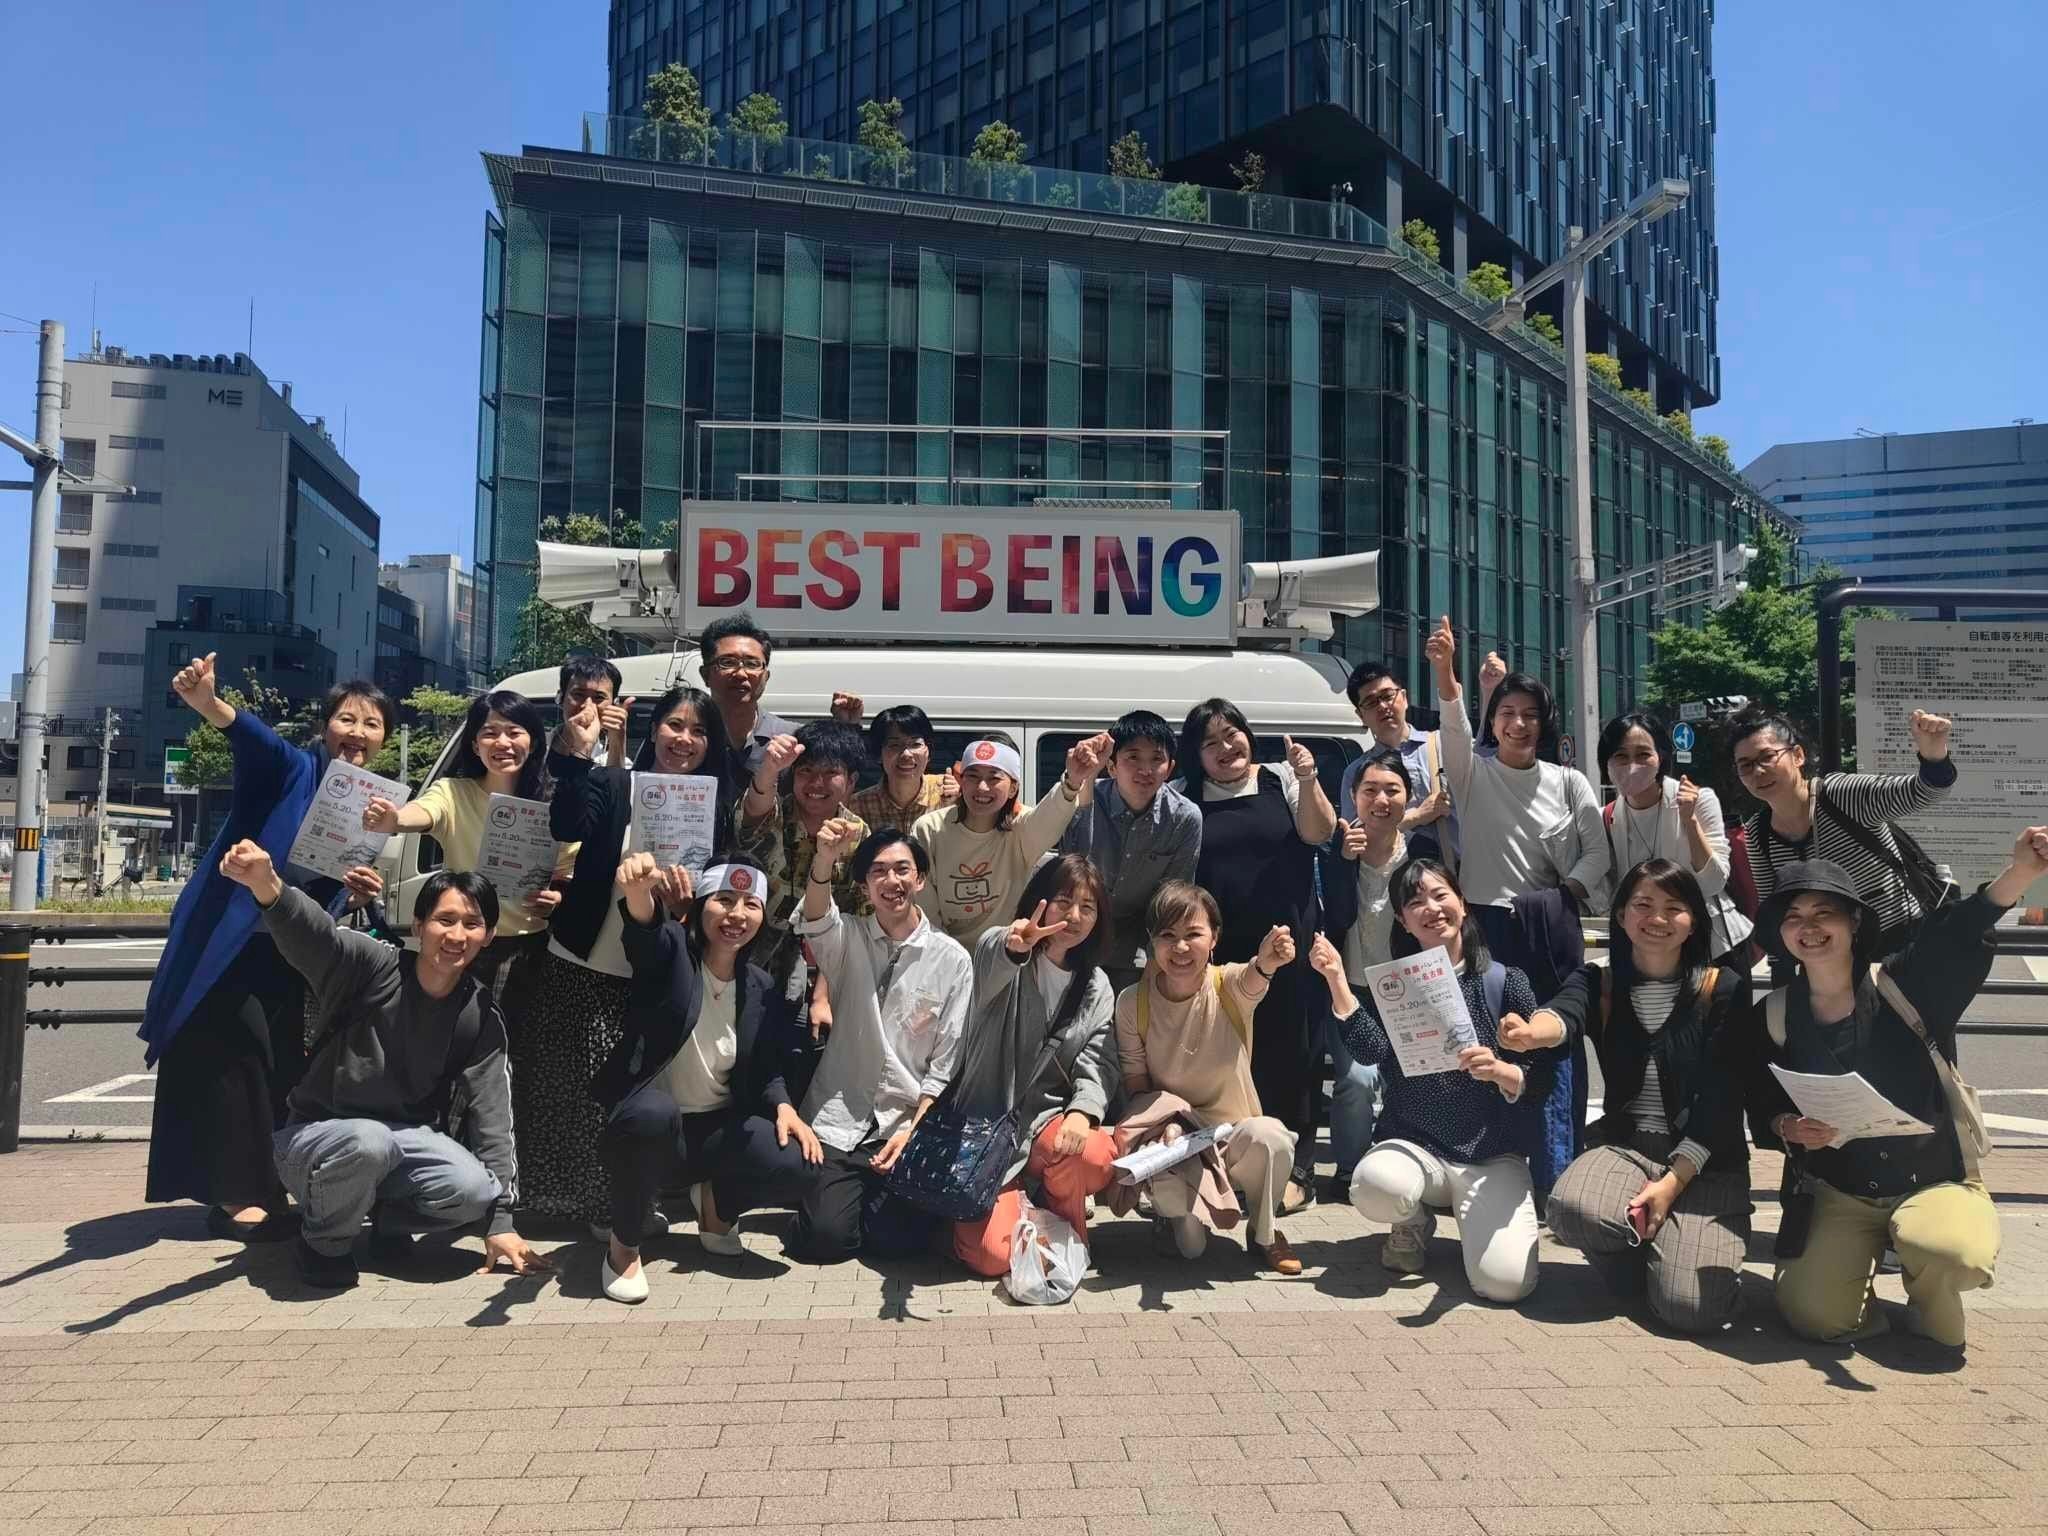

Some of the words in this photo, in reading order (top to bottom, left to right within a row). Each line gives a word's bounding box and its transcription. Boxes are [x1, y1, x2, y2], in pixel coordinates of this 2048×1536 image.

[208, 387, 244, 405] ME
[697, 527, 921, 612] BEST
[939, 532, 1222, 618] BEING
[1969, 631, 2048, 642] 自転車等を利用
